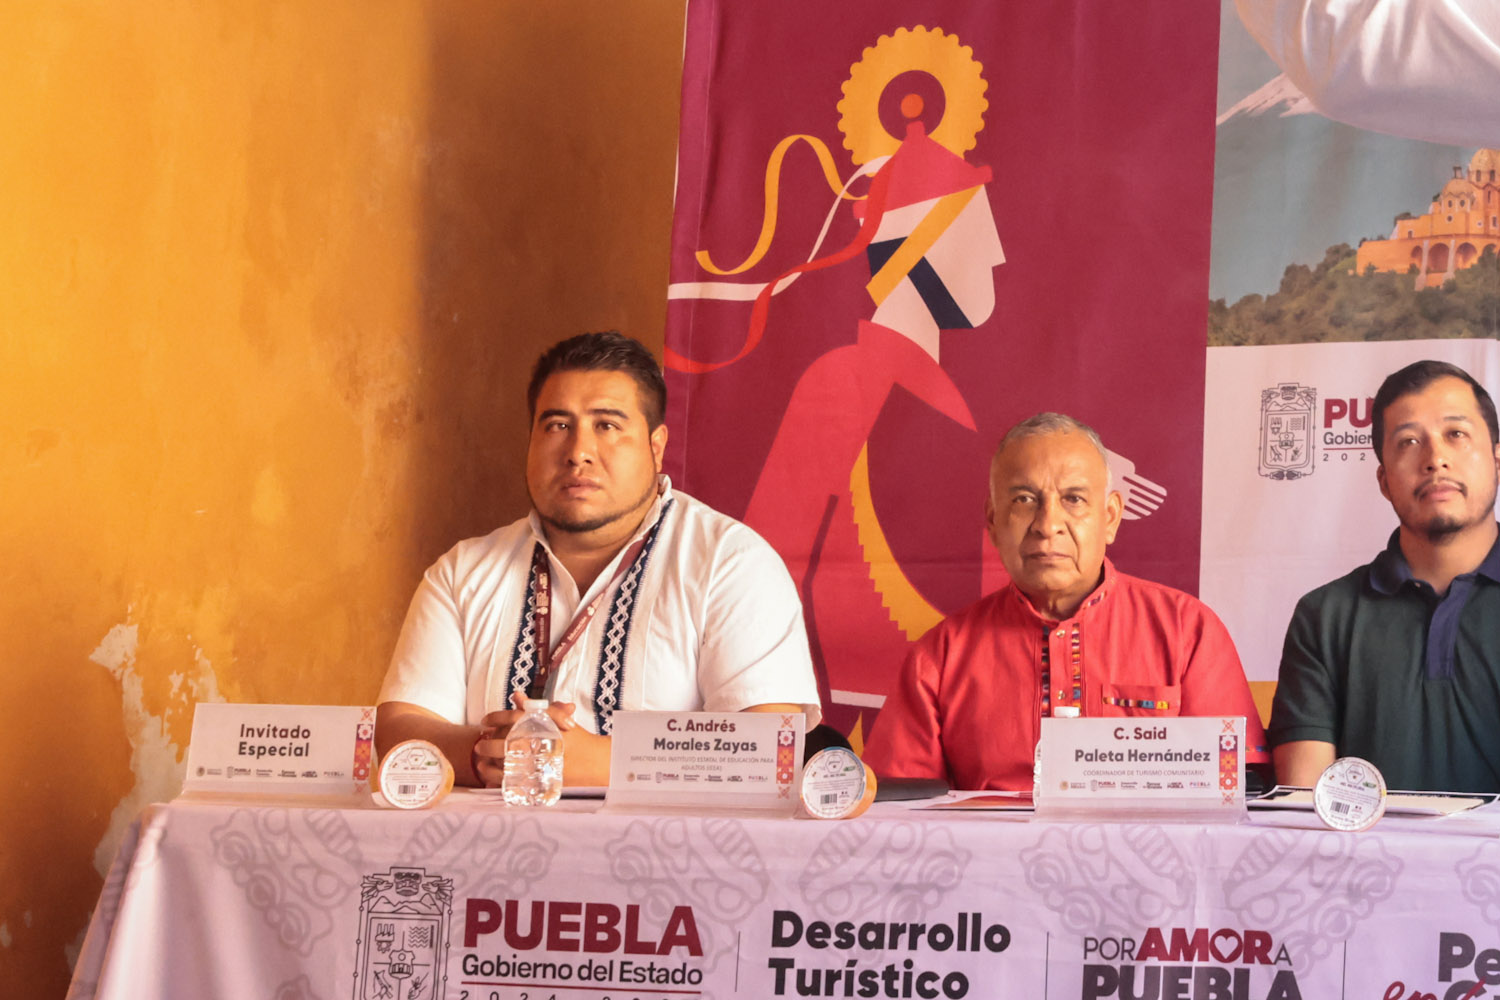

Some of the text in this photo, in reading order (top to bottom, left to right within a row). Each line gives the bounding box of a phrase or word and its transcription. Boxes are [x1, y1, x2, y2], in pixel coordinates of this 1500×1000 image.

[239, 724, 311, 739] Invitado
[667, 719, 736, 732] C. Andrés
[1114, 726, 1167, 740] C. Said
[238, 741, 310, 759] Especial
[654, 738, 757, 754] Morales Zayas
[1075, 749, 1210, 762] Paleta Hernández
[463, 898, 703, 957] PUEBLA
[771, 910, 1011, 952] Desarrollo
[1083, 937, 1136, 960] POR
[462, 954, 703, 985] Gobierno del Estado
[768, 958, 969, 999] Turístico
